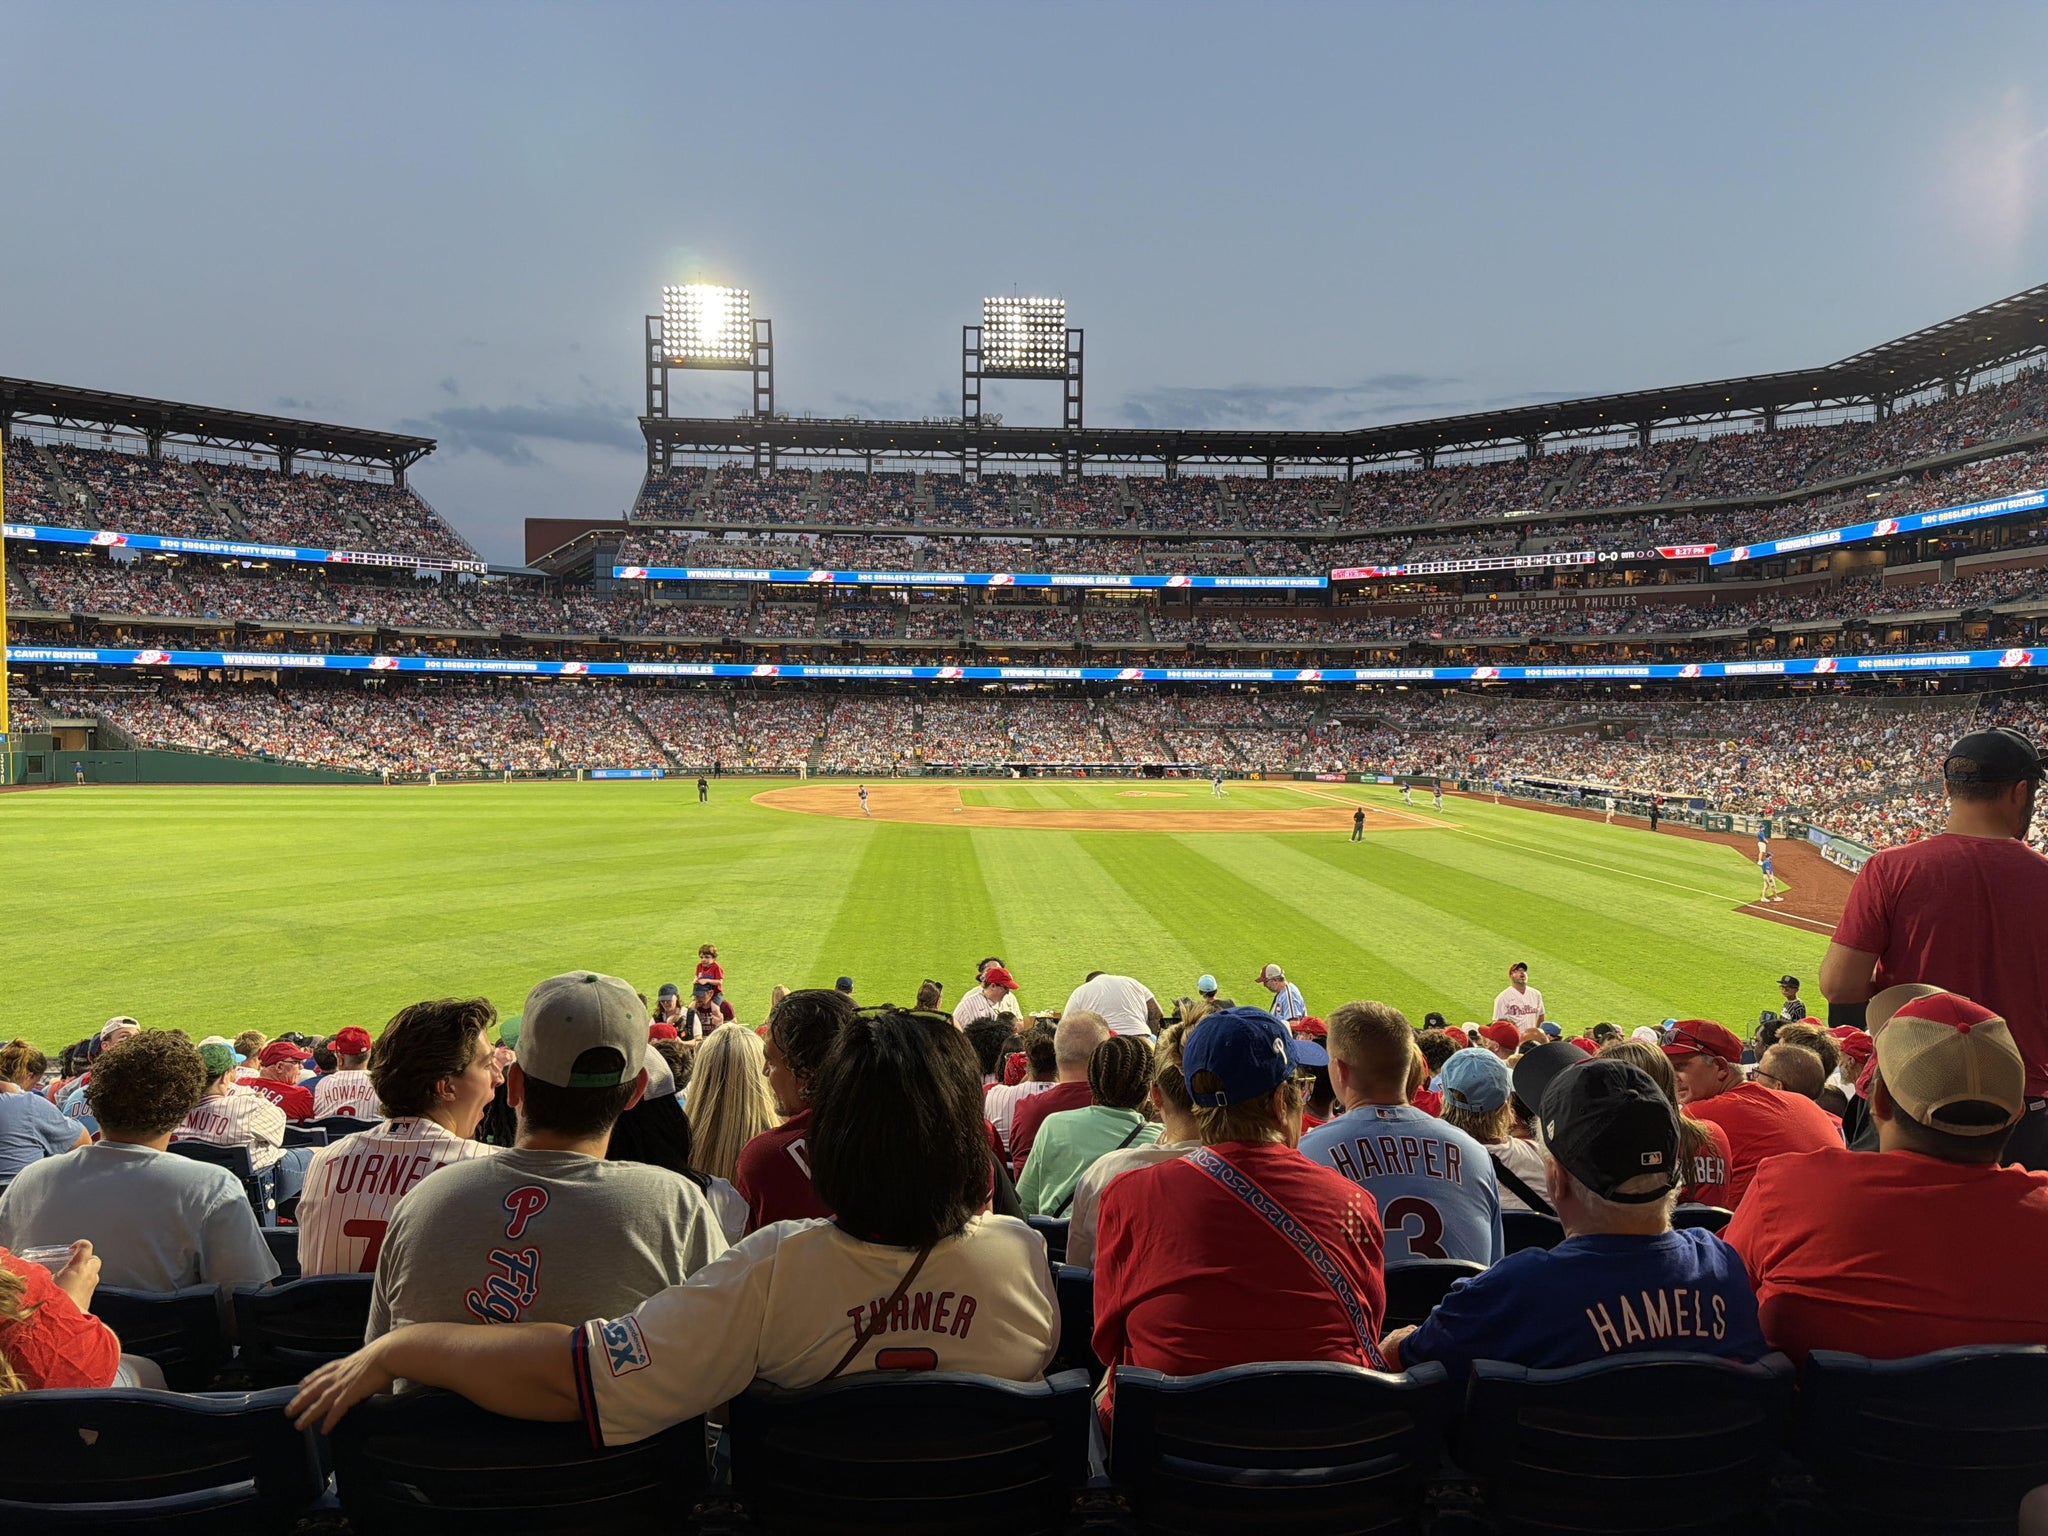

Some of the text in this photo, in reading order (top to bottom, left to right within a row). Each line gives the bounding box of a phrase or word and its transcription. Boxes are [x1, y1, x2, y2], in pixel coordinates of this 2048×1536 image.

[2008, 495, 2044, 509] BUSTERS
[4, 526, 35, 537] ILES
[1598, 552, 1618, 561] 0-0
[1422, 596, 1637, 615] HOME OF THE PHILADELPHIA PHILLIES
[222, 655, 325, 666] WINNING SMILES
[1510, 1004, 1537, 1016] Phillie
[324, 1085, 374, 1104] HOWARD
[180, 1111, 229, 1136] MUTO
[1328, 1135, 1462, 1186] HARPER
[1694, 1156, 1725, 1185] BER
[324, 1154, 452, 1198] TURNE
[504, 1184, 550, 1239] P
[1382, 1195, 1450, 1259] 3
[344, 1219, 388, 1272] 7
[847, 1292, 977, 1339] TURNER
[1585, 1287, 1726, 1352] HAMELS
[602, 1322, 638, 1372] BX
